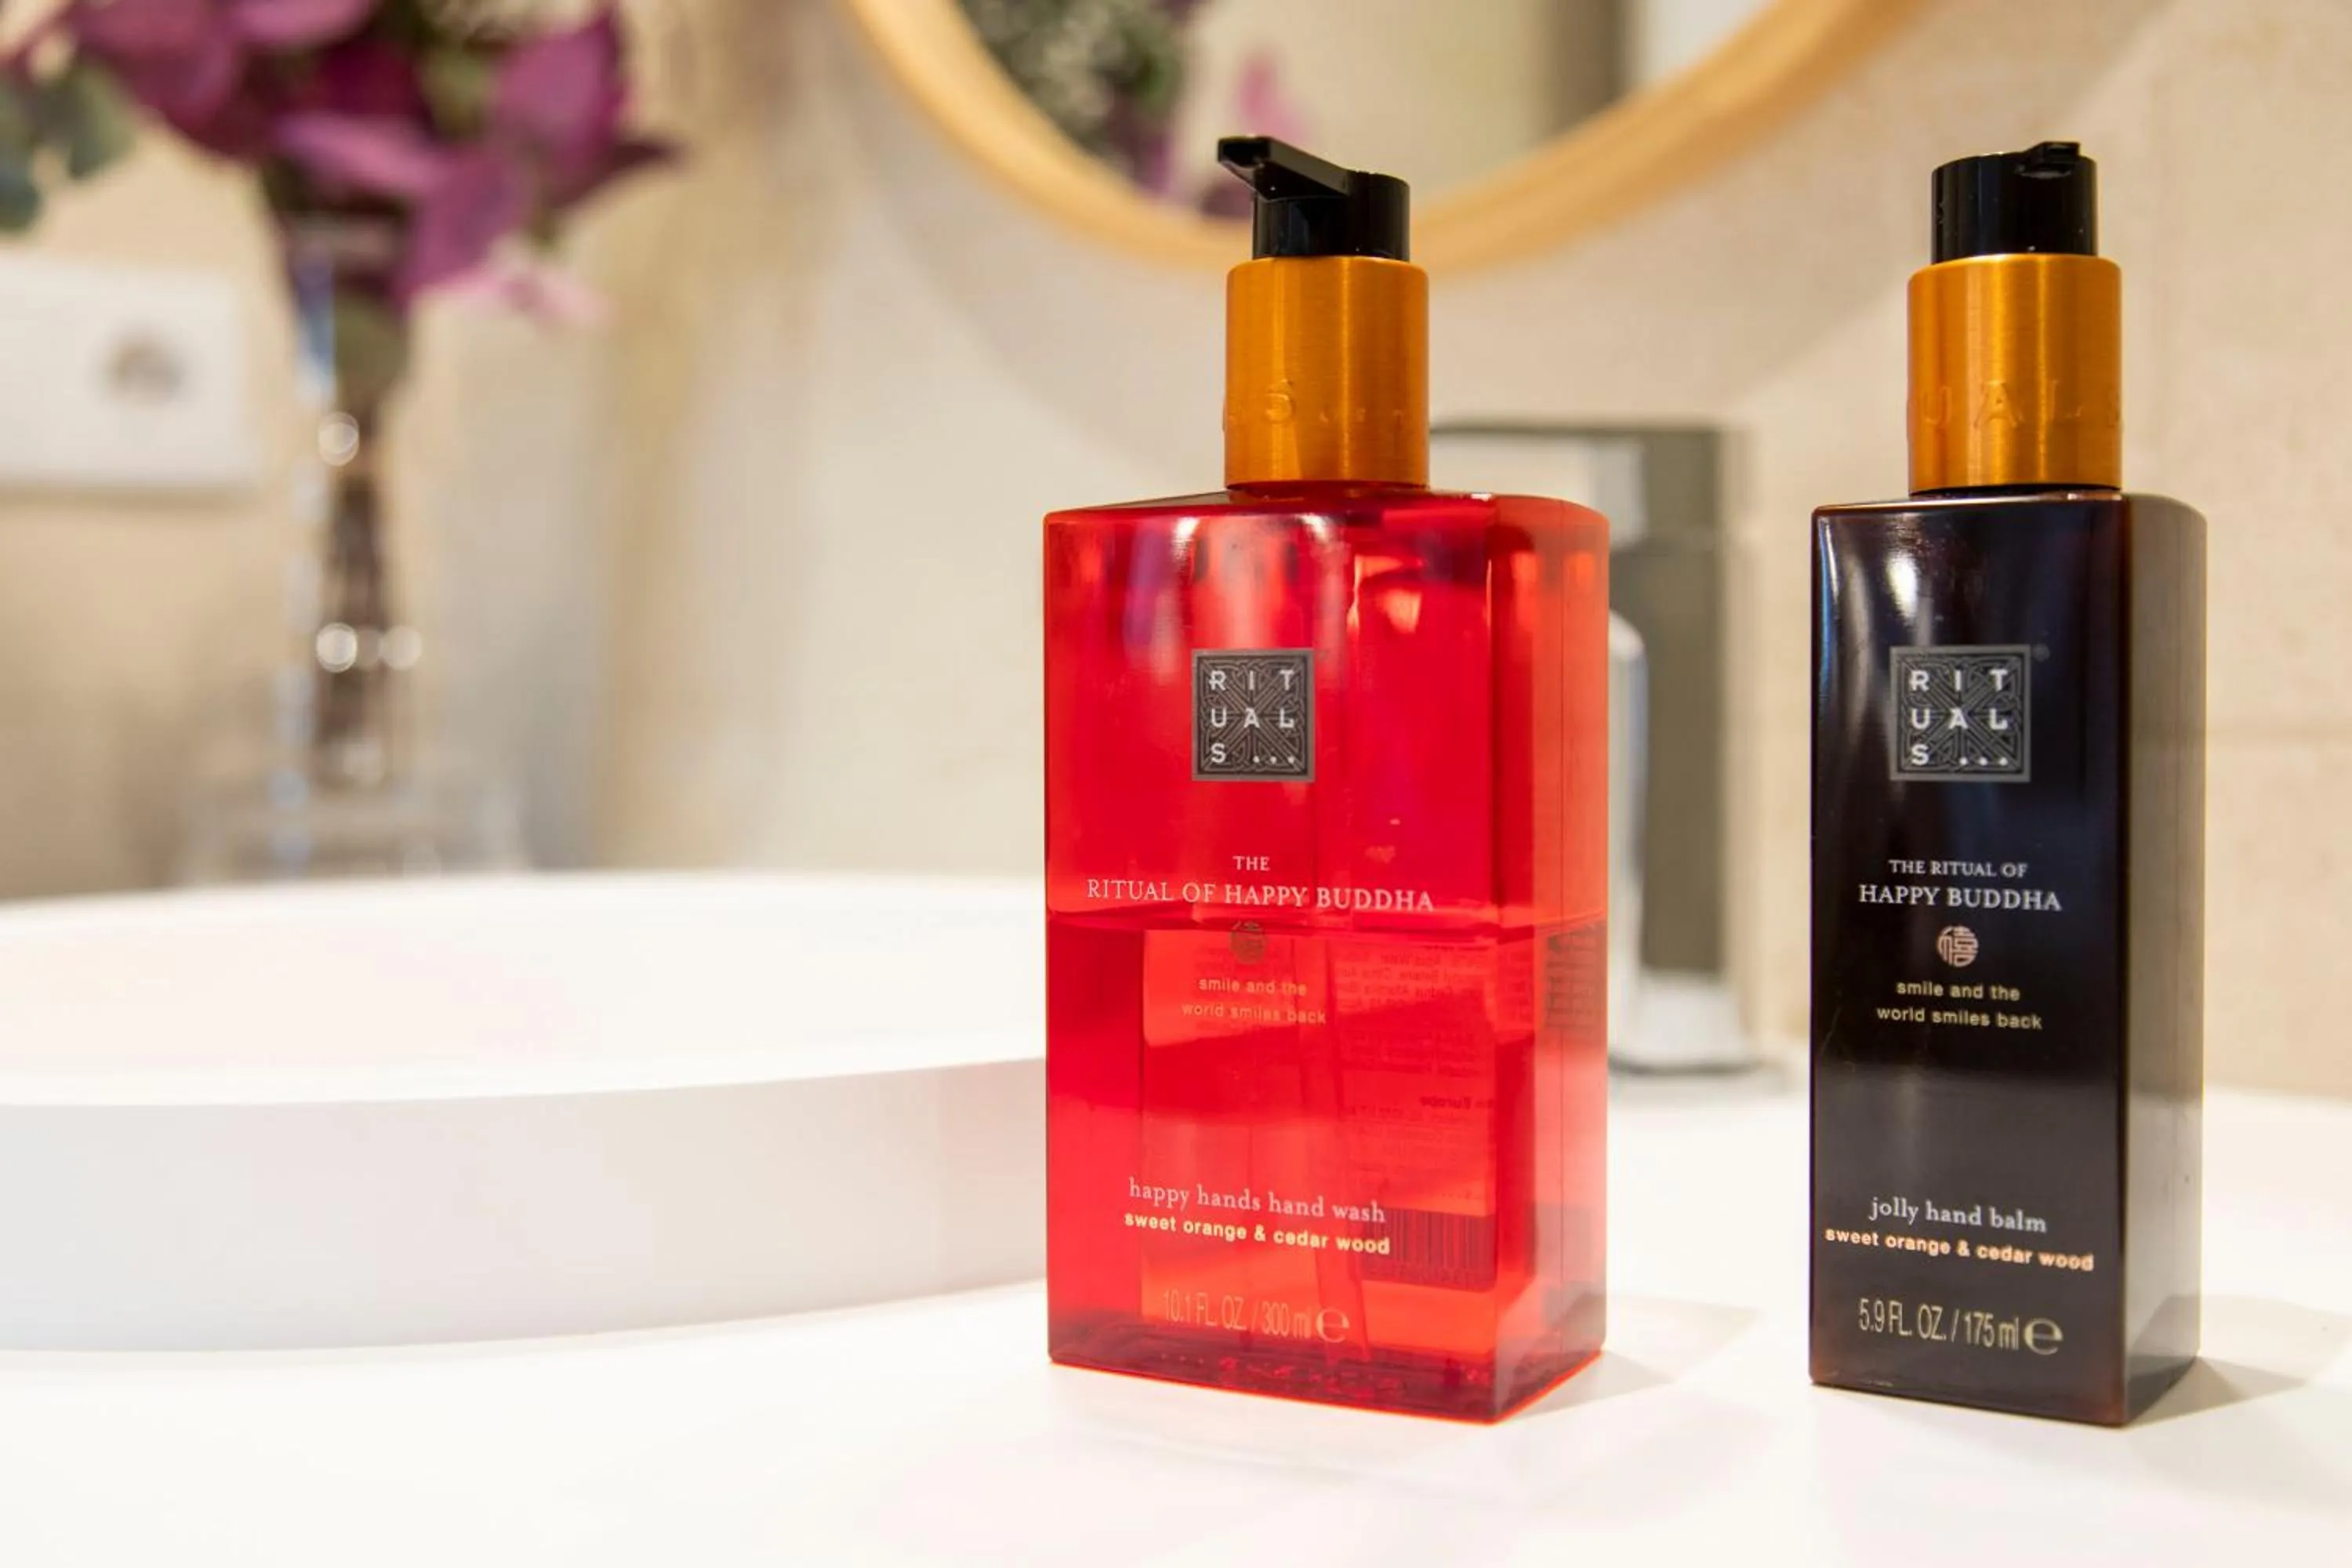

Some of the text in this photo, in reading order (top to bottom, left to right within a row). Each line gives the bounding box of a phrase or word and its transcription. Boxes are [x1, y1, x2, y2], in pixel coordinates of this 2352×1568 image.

[1232, 855, 1270, 871] THE
[1889, 859, 2027, 879] THE RITUAL OF
[1087, 879, 1434, 912] RITUAL OF HAPPY BUDDHA
[1859, 884, 2063, 911] HAPPY BUDDHA
[1199, 978, 1307, 996] smile and the
[1896, 980, 2020, 1001] smile and the
[1181, 1003, 1326, 1025] world smiles back
[1877, 1005, 2043, 1030] world smiles back
[1129, 1176, 1386, 1223] happy hands hand wash
[1868, 1197, 2047, 1234] jolly hand balm
[1124, 1212, 1390, 1255] sweet orange & cedar wood
[1825, 1227, 2094, 1272] sweet orange & cedar wood
[1163, 1289, 1191, 1323] 10.1
[1261, 1301, 1290, 1338] 300
[1858, 1298, 1885, 1333] 5.9
[1918, 1304, 1947, 1340] OZ.
[1951, 1308, 1960, 1342] /
[1964, 1312, 1995, 1348] 175
